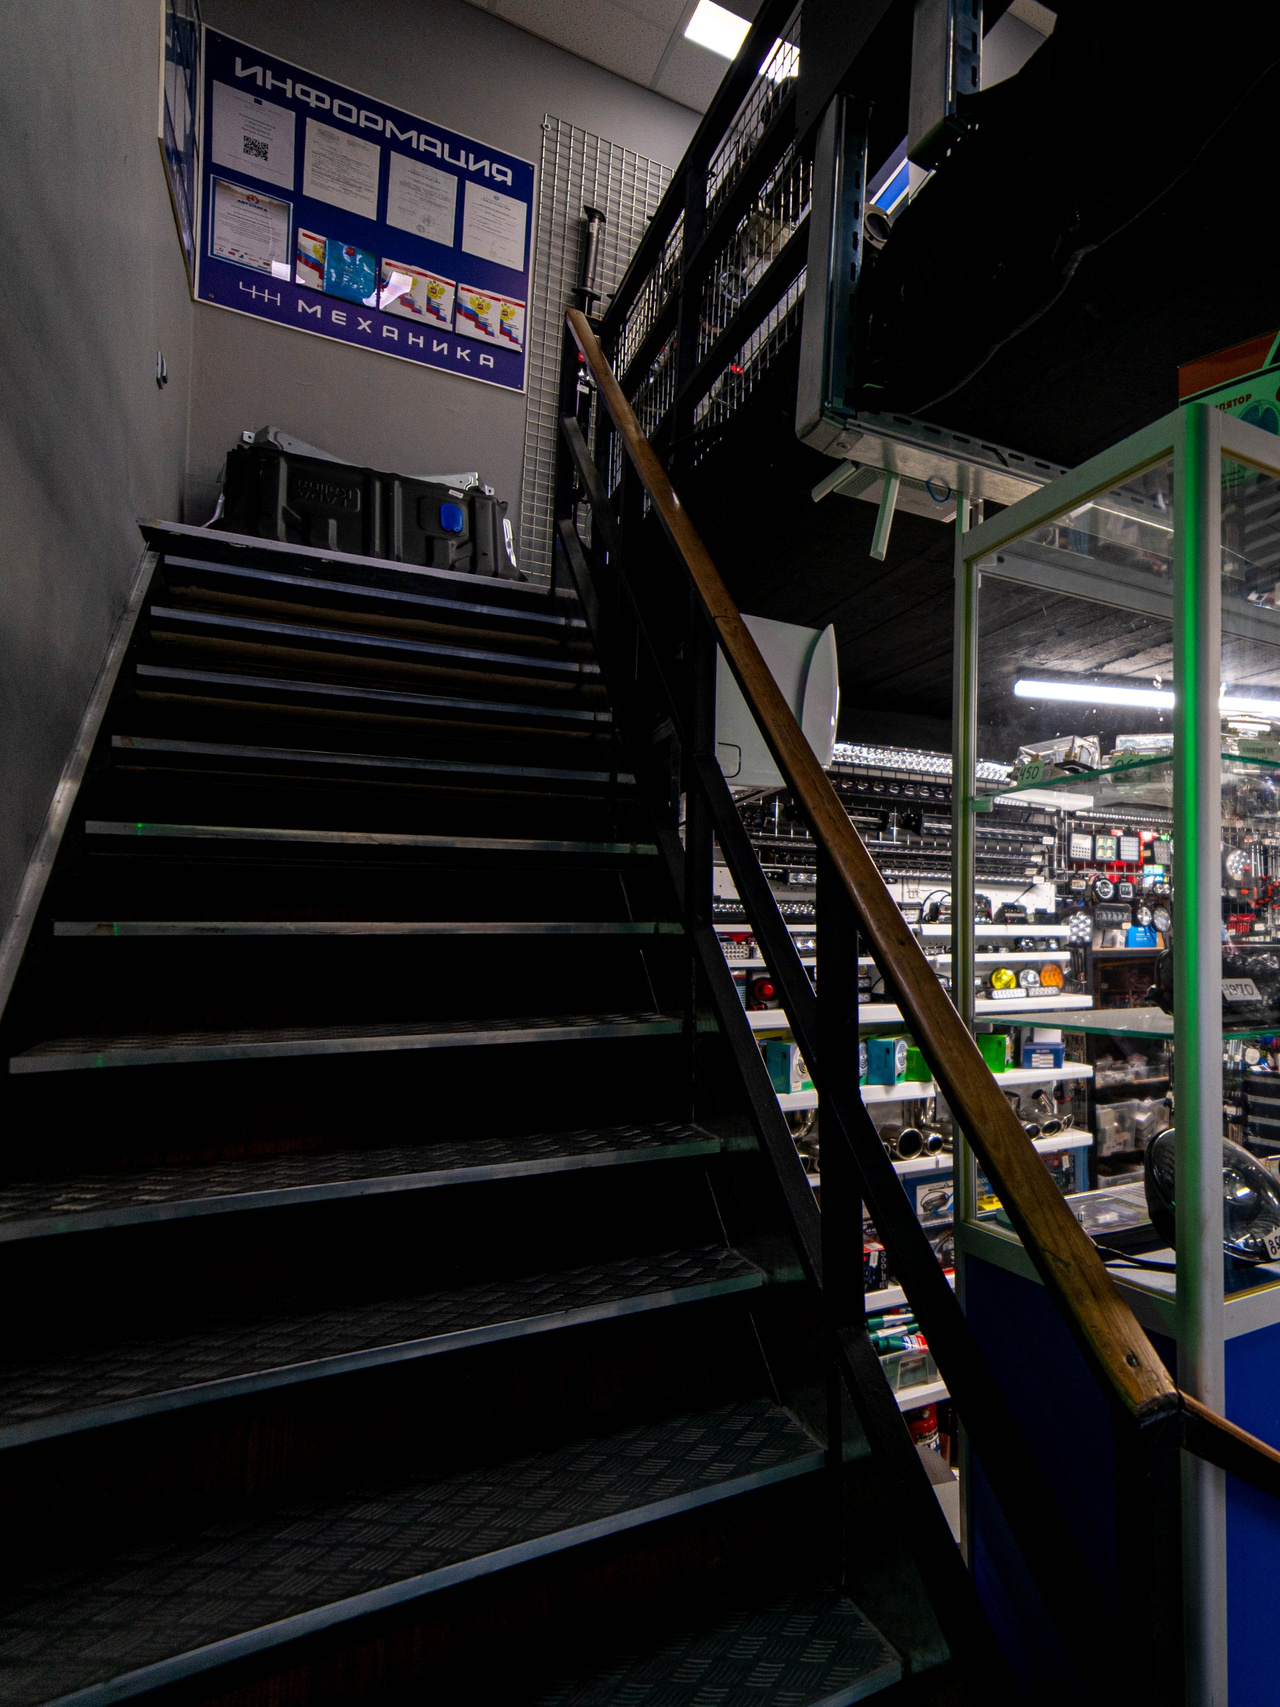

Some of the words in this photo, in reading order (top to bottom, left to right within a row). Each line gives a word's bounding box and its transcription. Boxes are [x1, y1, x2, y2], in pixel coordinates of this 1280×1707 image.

[235, 56, 513, 187] ИНФОРМАЦИЯ
[297, 299, 495, 369] МЕХАНИКА
[1018, 766, 1039, 780] 450
